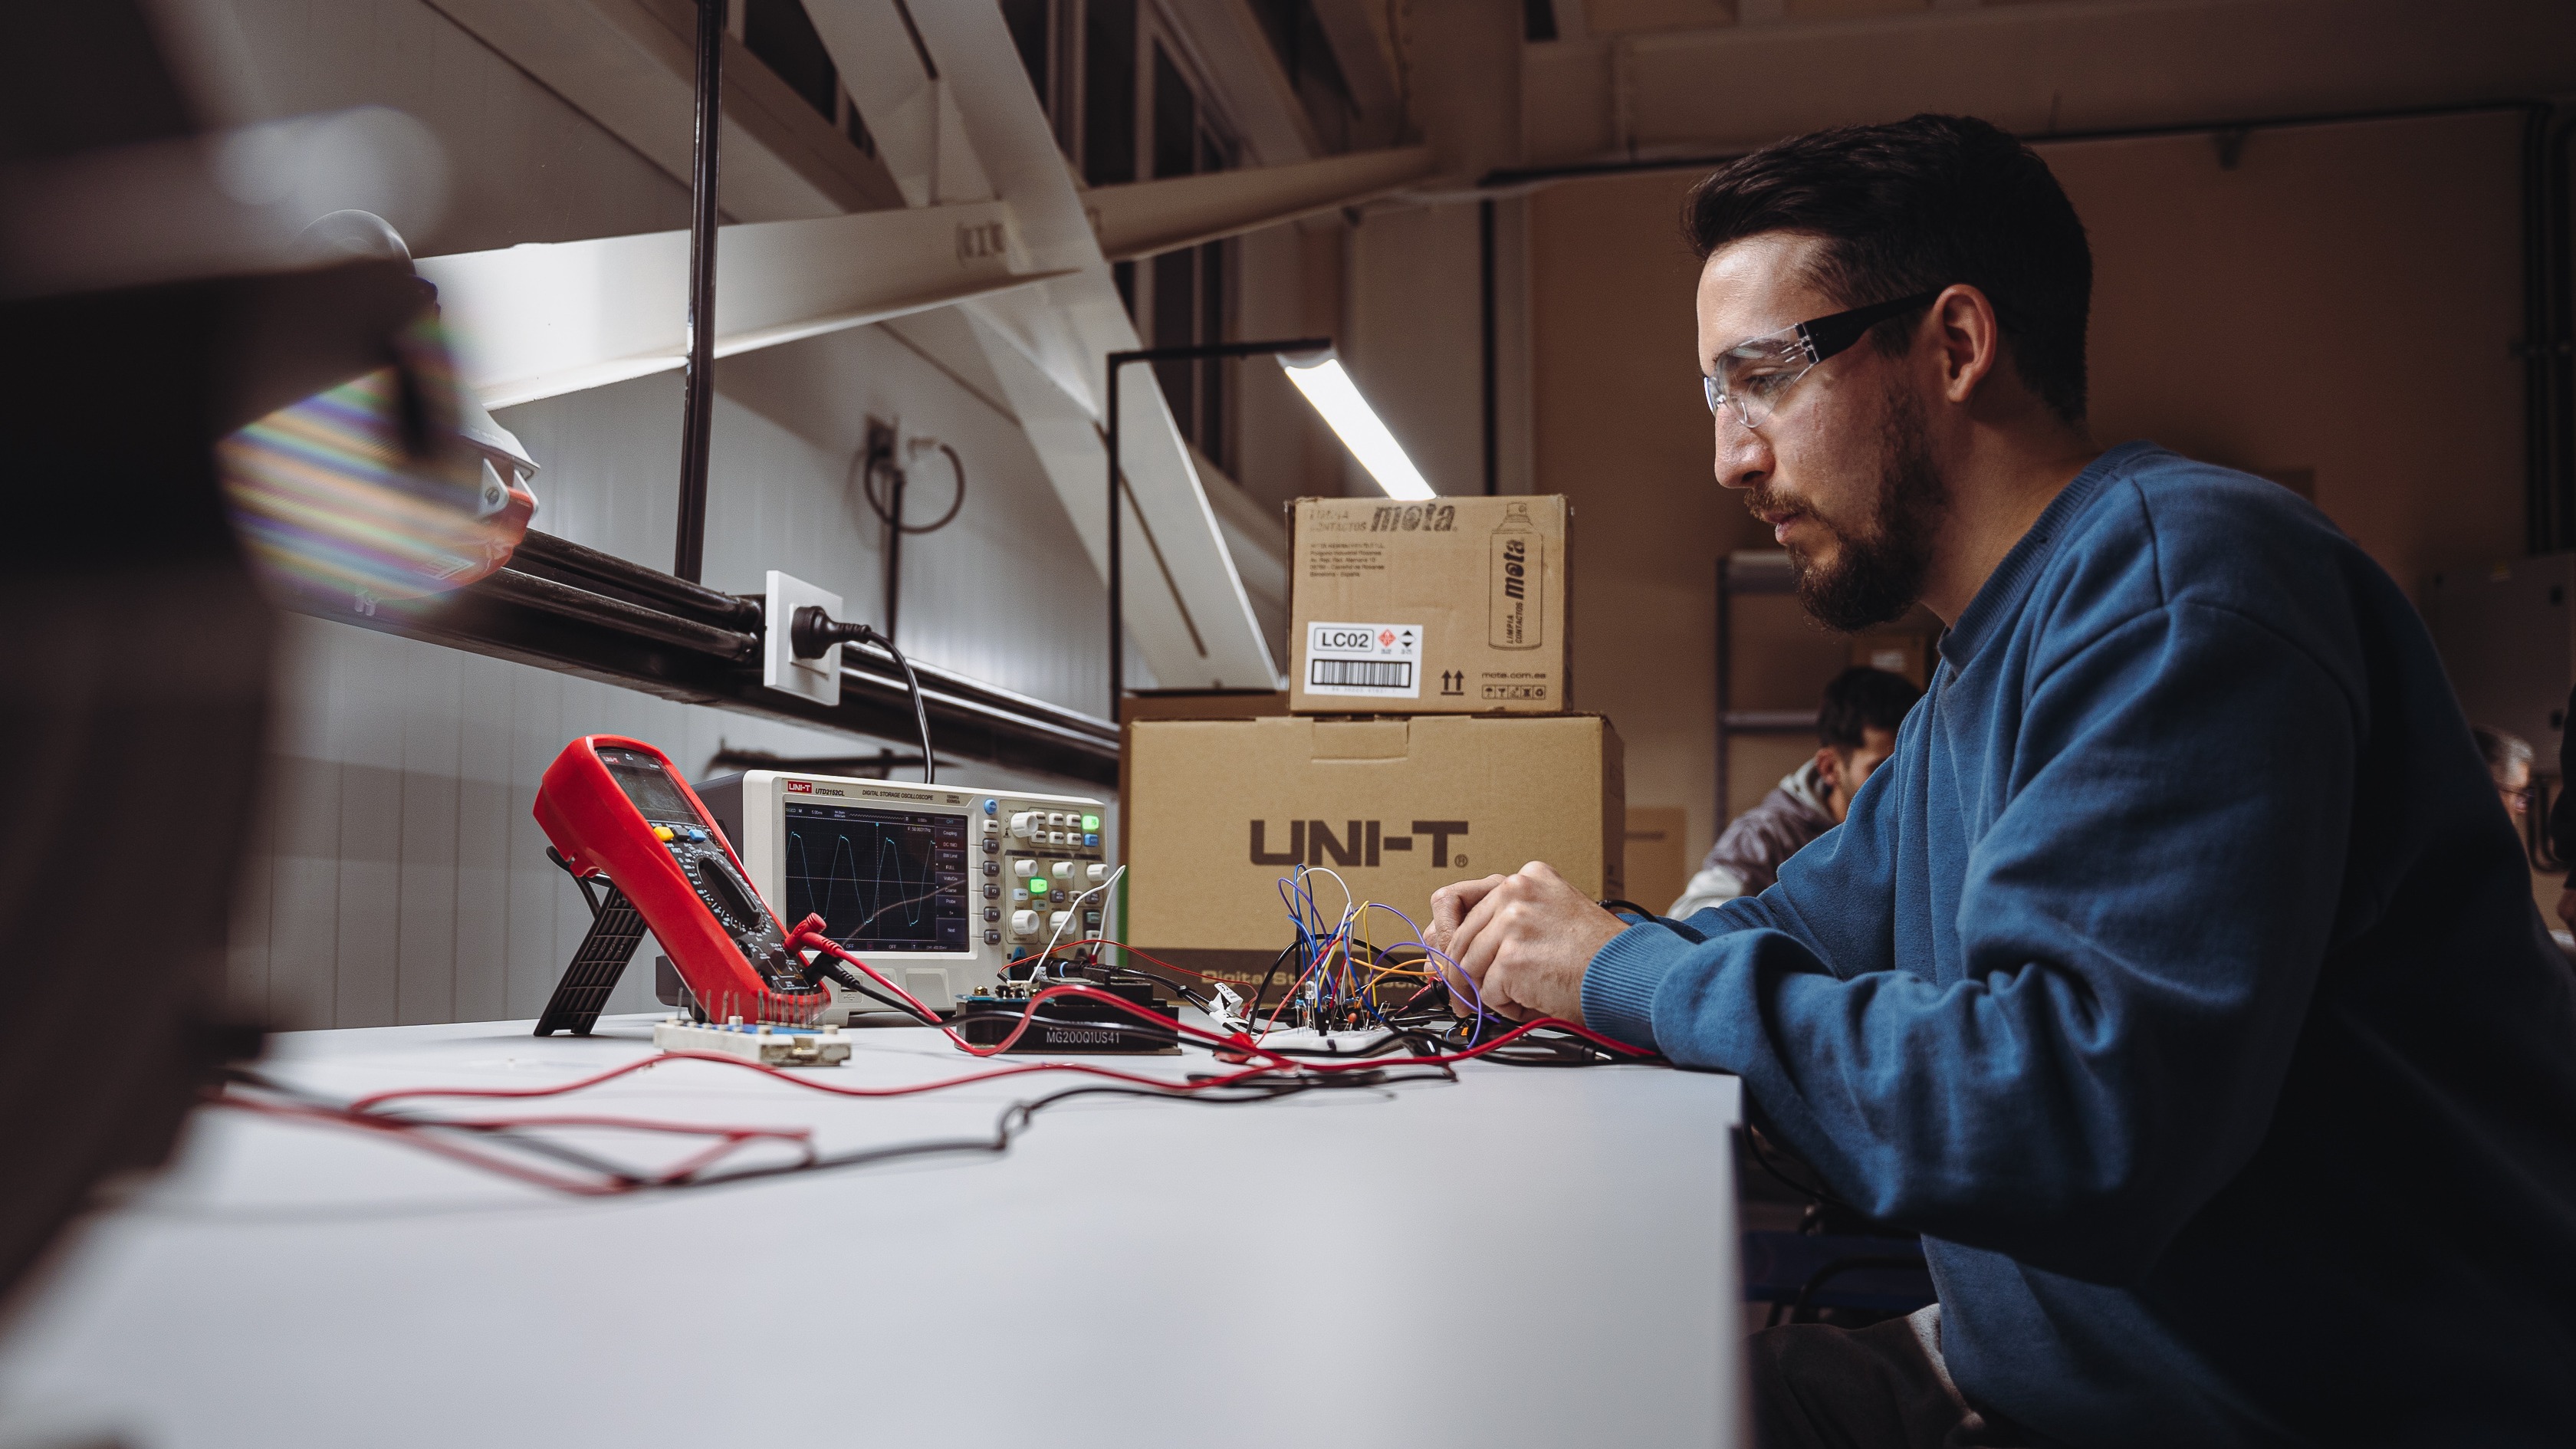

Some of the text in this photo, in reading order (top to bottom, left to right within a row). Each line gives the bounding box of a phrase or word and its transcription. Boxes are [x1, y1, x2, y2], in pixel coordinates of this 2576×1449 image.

[1370, 503, 1456, 532] mota
[1503, 539, 1525, 600] mota
[1515, 602, 1523, 644] CONTACTOS
[1322, 632, 1368, 648] LC02
[788, 782, 811, 792] UNI-T
